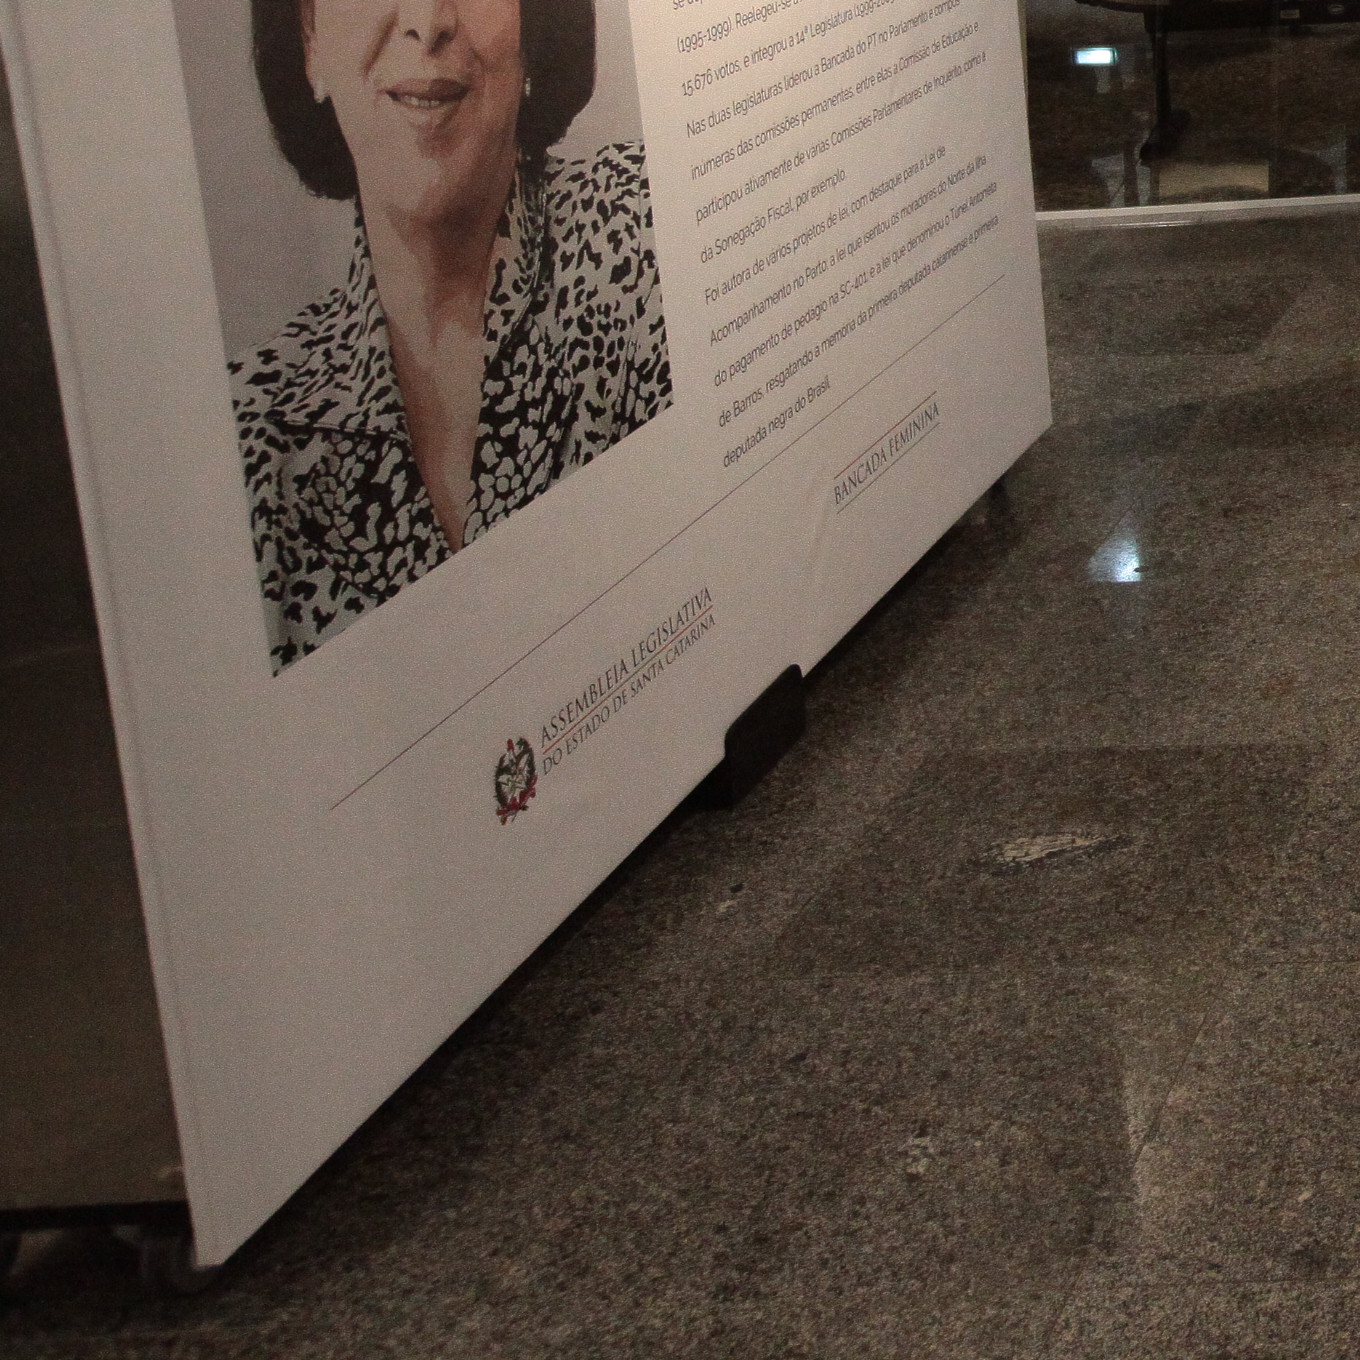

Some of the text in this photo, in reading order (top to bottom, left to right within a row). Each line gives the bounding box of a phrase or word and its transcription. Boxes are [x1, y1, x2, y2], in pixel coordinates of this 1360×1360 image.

[700, 246, 714, 264] da
[714, 215, 766, 256] Sonegação
[795, 189, 809, 212] por
[722, 425, 767, 468] deputada
[767, 406, 793, 434] negra
[794, 395, 806, 413] do
[833, 403, 940, 505] BANCADA FEMININA
[540, 586, 713, 748] ASSEMBLEIA LEGISLATIVA
[542, 613, 716, 776] DO ESTADO DE SANTA CATARINA
